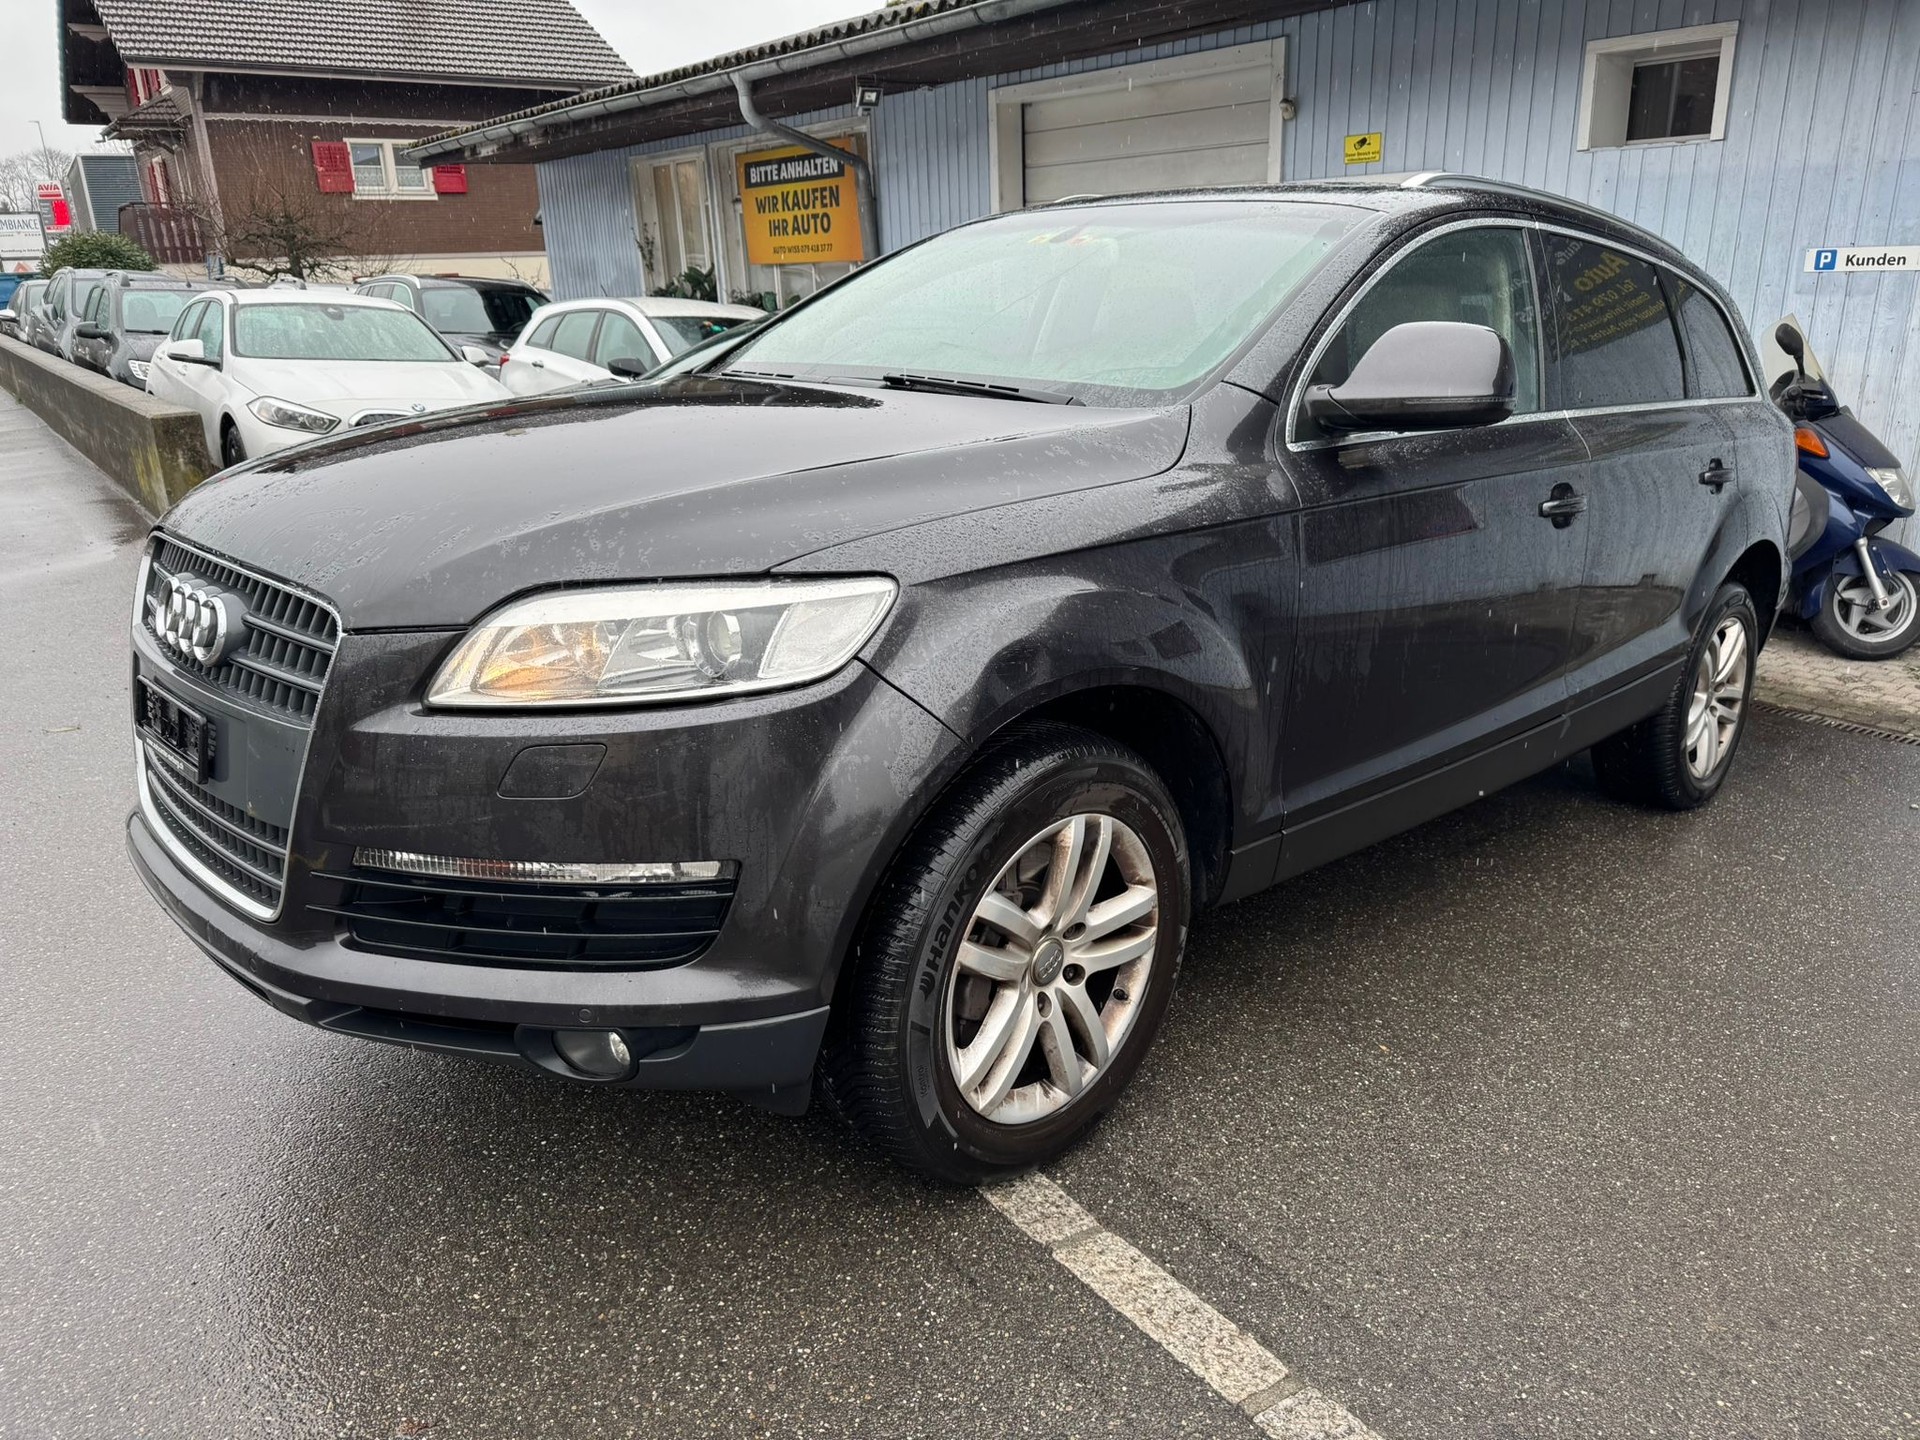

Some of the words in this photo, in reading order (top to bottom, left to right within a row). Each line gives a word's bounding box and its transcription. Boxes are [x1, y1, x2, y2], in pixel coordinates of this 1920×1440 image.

[750, 163, 779, 183] BITTE
[780, 157, 838, 180] ANHALTEN
[38, 183, 60, 191] AVIA
[755, 195, 779, 214] WIR
[781, 185, 840, 212] KAUFEN
[0, 218, 39, 230] MBIANCE
[769, 219, 789, 237] IHR
[791, 212, 831, 236] AUTO
[773, 246, 786, 254] AUTO
[1819, 252, 1831, 268] P
[1845, 253, 1907, 266] Kunden
